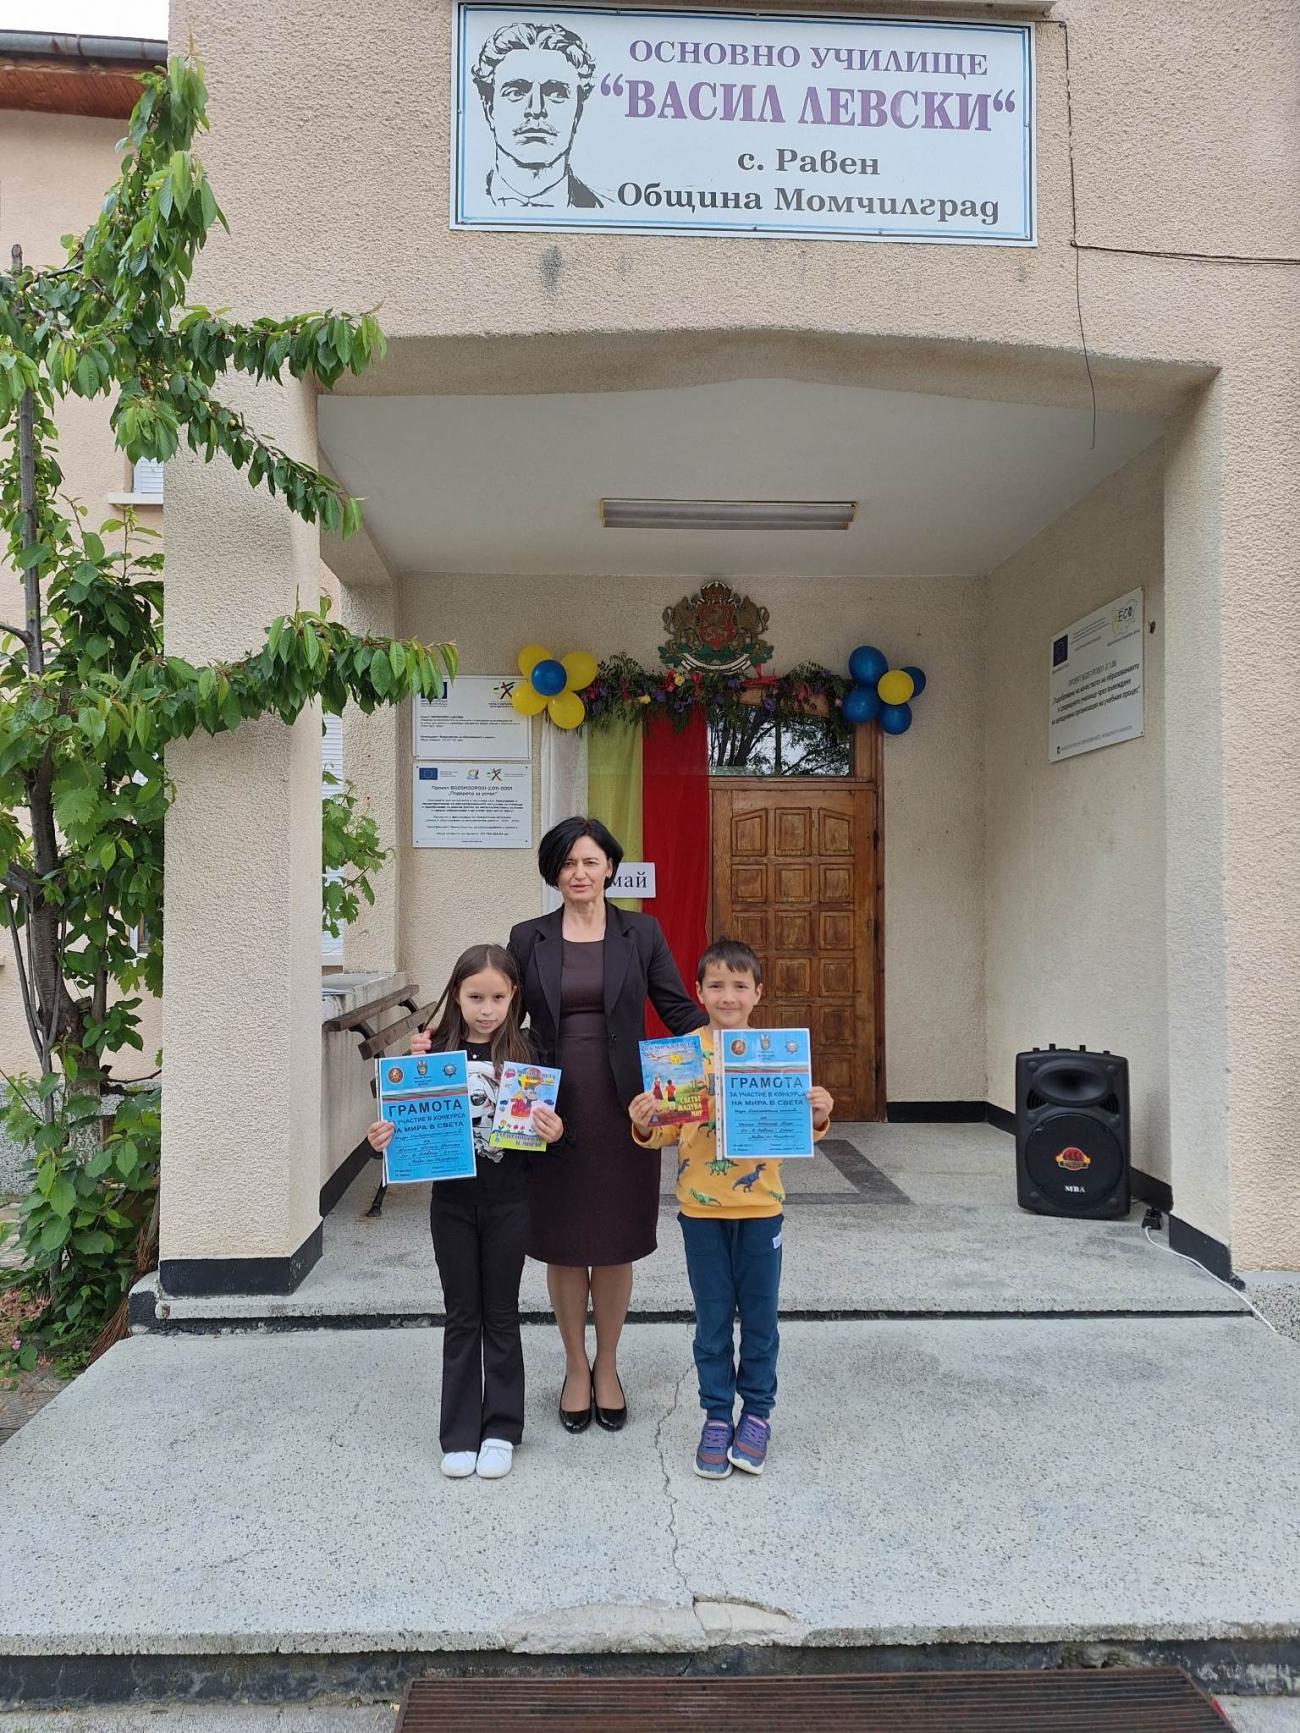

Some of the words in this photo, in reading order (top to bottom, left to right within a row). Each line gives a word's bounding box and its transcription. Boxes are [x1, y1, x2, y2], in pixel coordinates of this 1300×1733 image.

[629, 39, 801, 69] ОСНОВНО
[810, 45, 989, 79] УЧИЛИЩЕ
[600, 72, 786, 123] “ВАСИЛ
[798, 86, 1017, 132] ЛЕВСКИ“
[738, 151, 766, 173] с.
[775, 148, 880, 176] Равен
[617, 182, 763, 213] Община
[773, 187, 999, 225] Момчилград
[730, 1076, 804, 1088] ГРАМОТА
[388, 1098, 463, 1118] ГРАМОТА
[398, 1116, 426, 1125] УЧАСТИЕ
[434, 1112, 467, 1120] КОНКУРСА
[404, 1124, 428, 1132] МИРА
[1064, 1184, 1086, 1193] MBA
